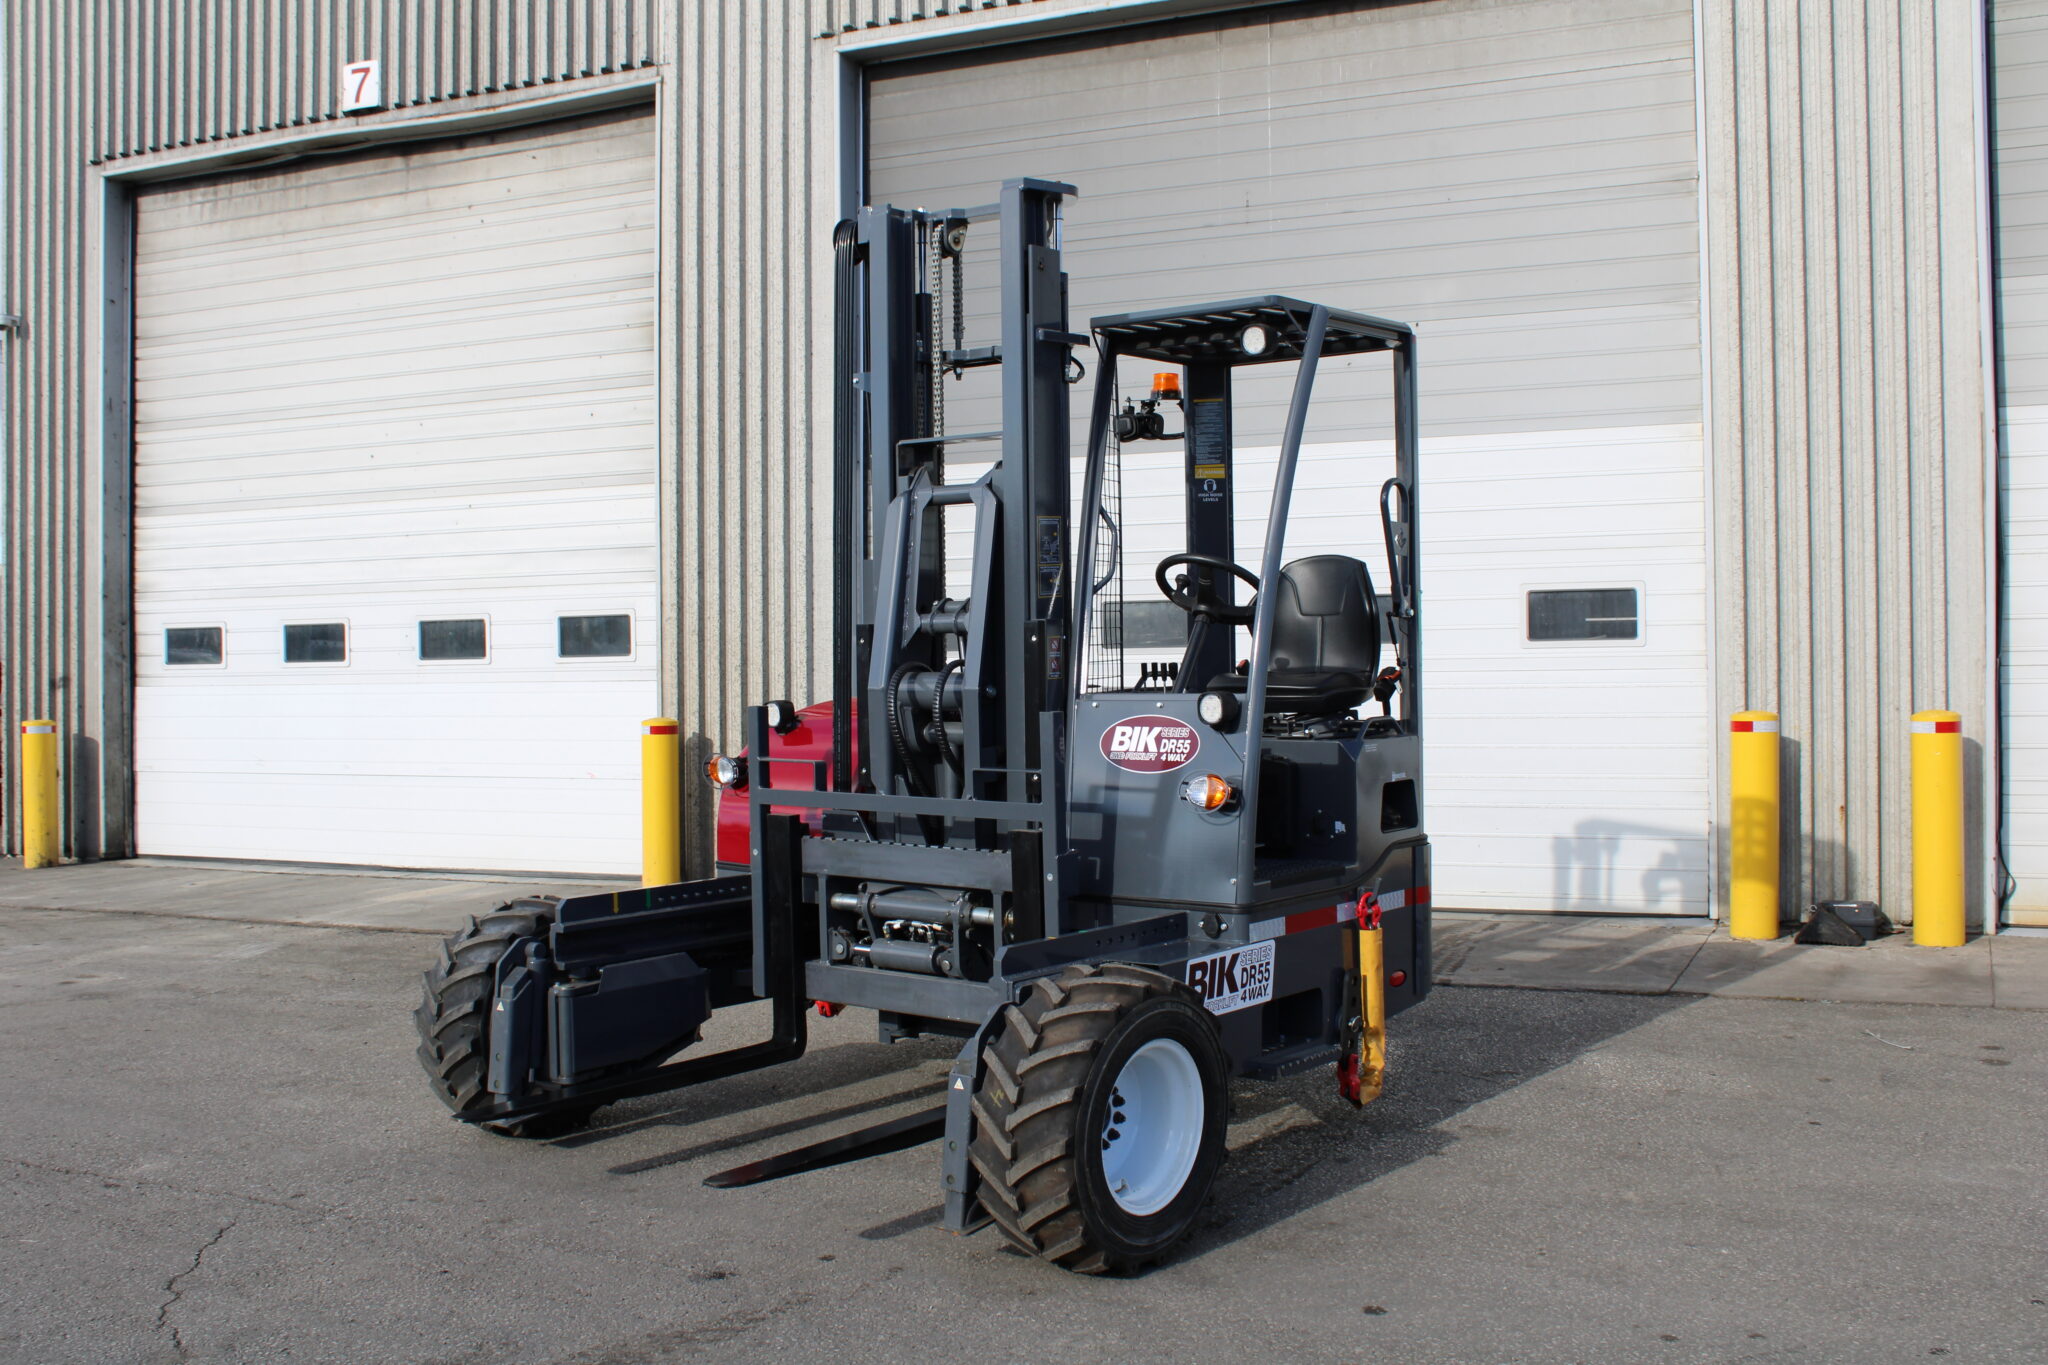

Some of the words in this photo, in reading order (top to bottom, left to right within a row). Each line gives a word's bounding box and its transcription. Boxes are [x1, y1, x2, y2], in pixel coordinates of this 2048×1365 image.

[350, 66, 371, 104] 7
[1110, 726, 1162, 752] BIK
[1160, 727, 1190, 737] SERIES
[1160, 739, 1191, 753] DR55
[1240, 945, 1273, 966] SERIES
[1188, 952, 1240, 1000] BIK
[1240, 961, 1271, 989] DR55
